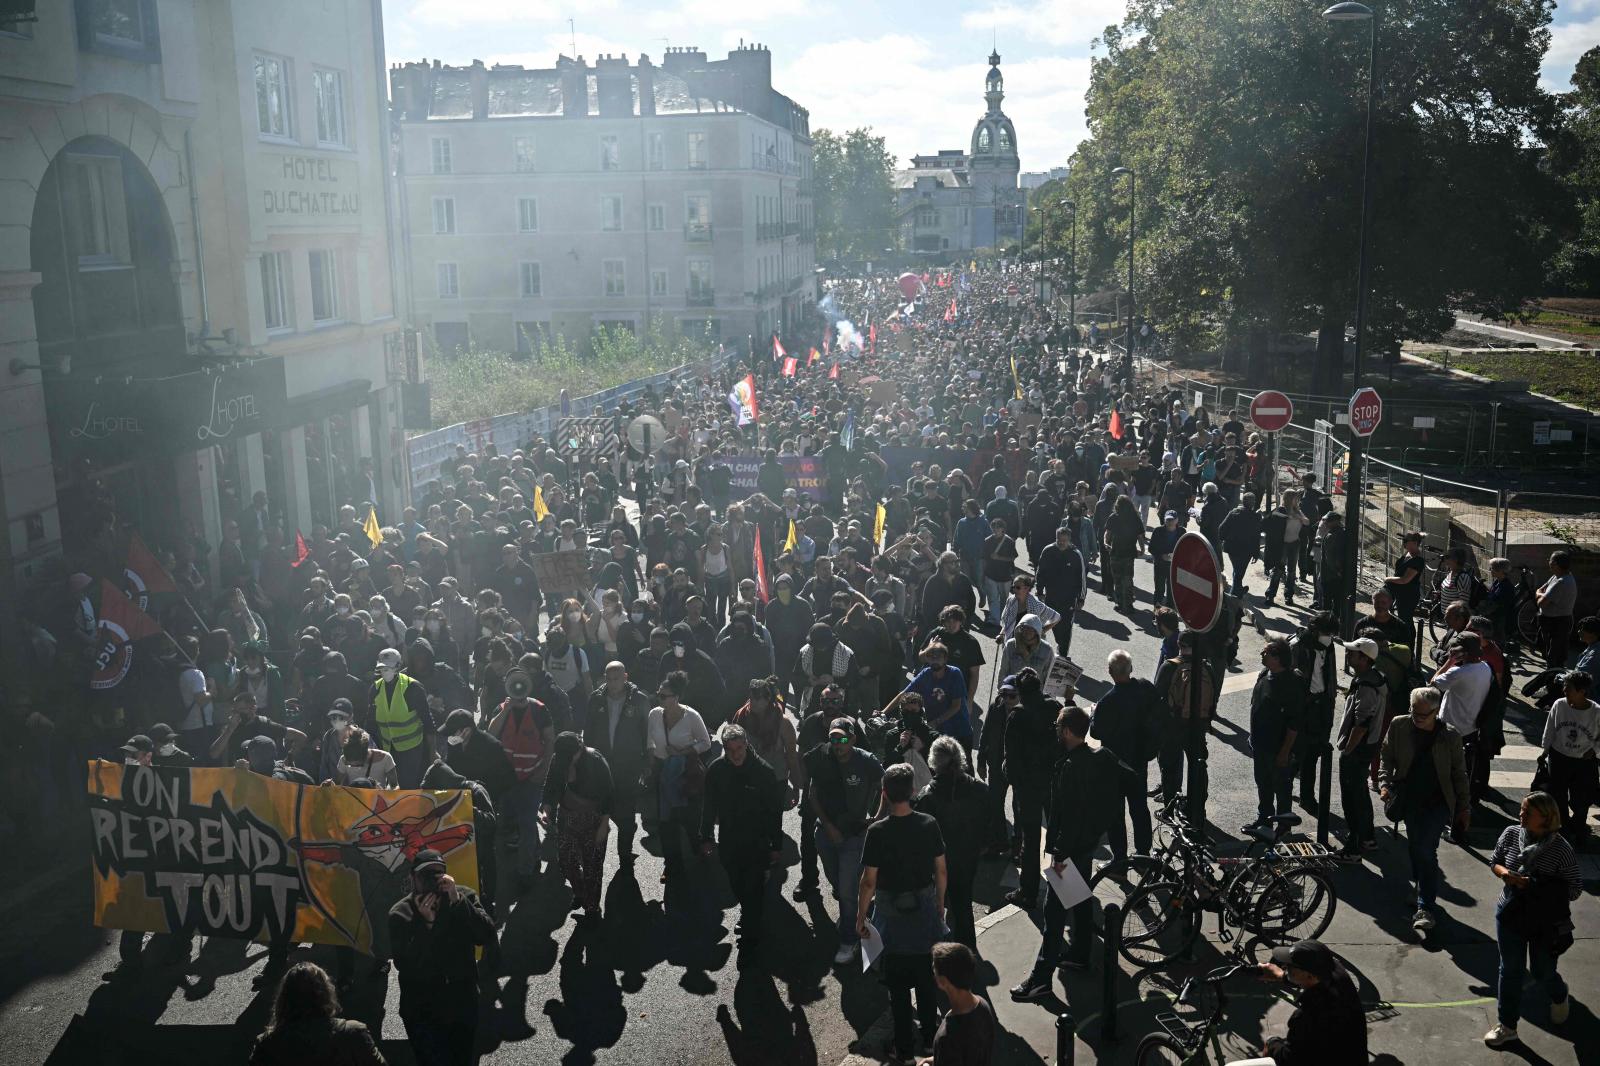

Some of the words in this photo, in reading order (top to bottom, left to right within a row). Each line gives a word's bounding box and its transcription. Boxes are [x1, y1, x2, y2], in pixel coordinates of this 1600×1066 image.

[283, 156, 338, 182] HOTEL
[1354, 405, 1379, 420] STOP
[132, 766, 179, 818] ON
[91, 808, 281, 873] REPREND
[155, 872, 300, 934] TOUT
